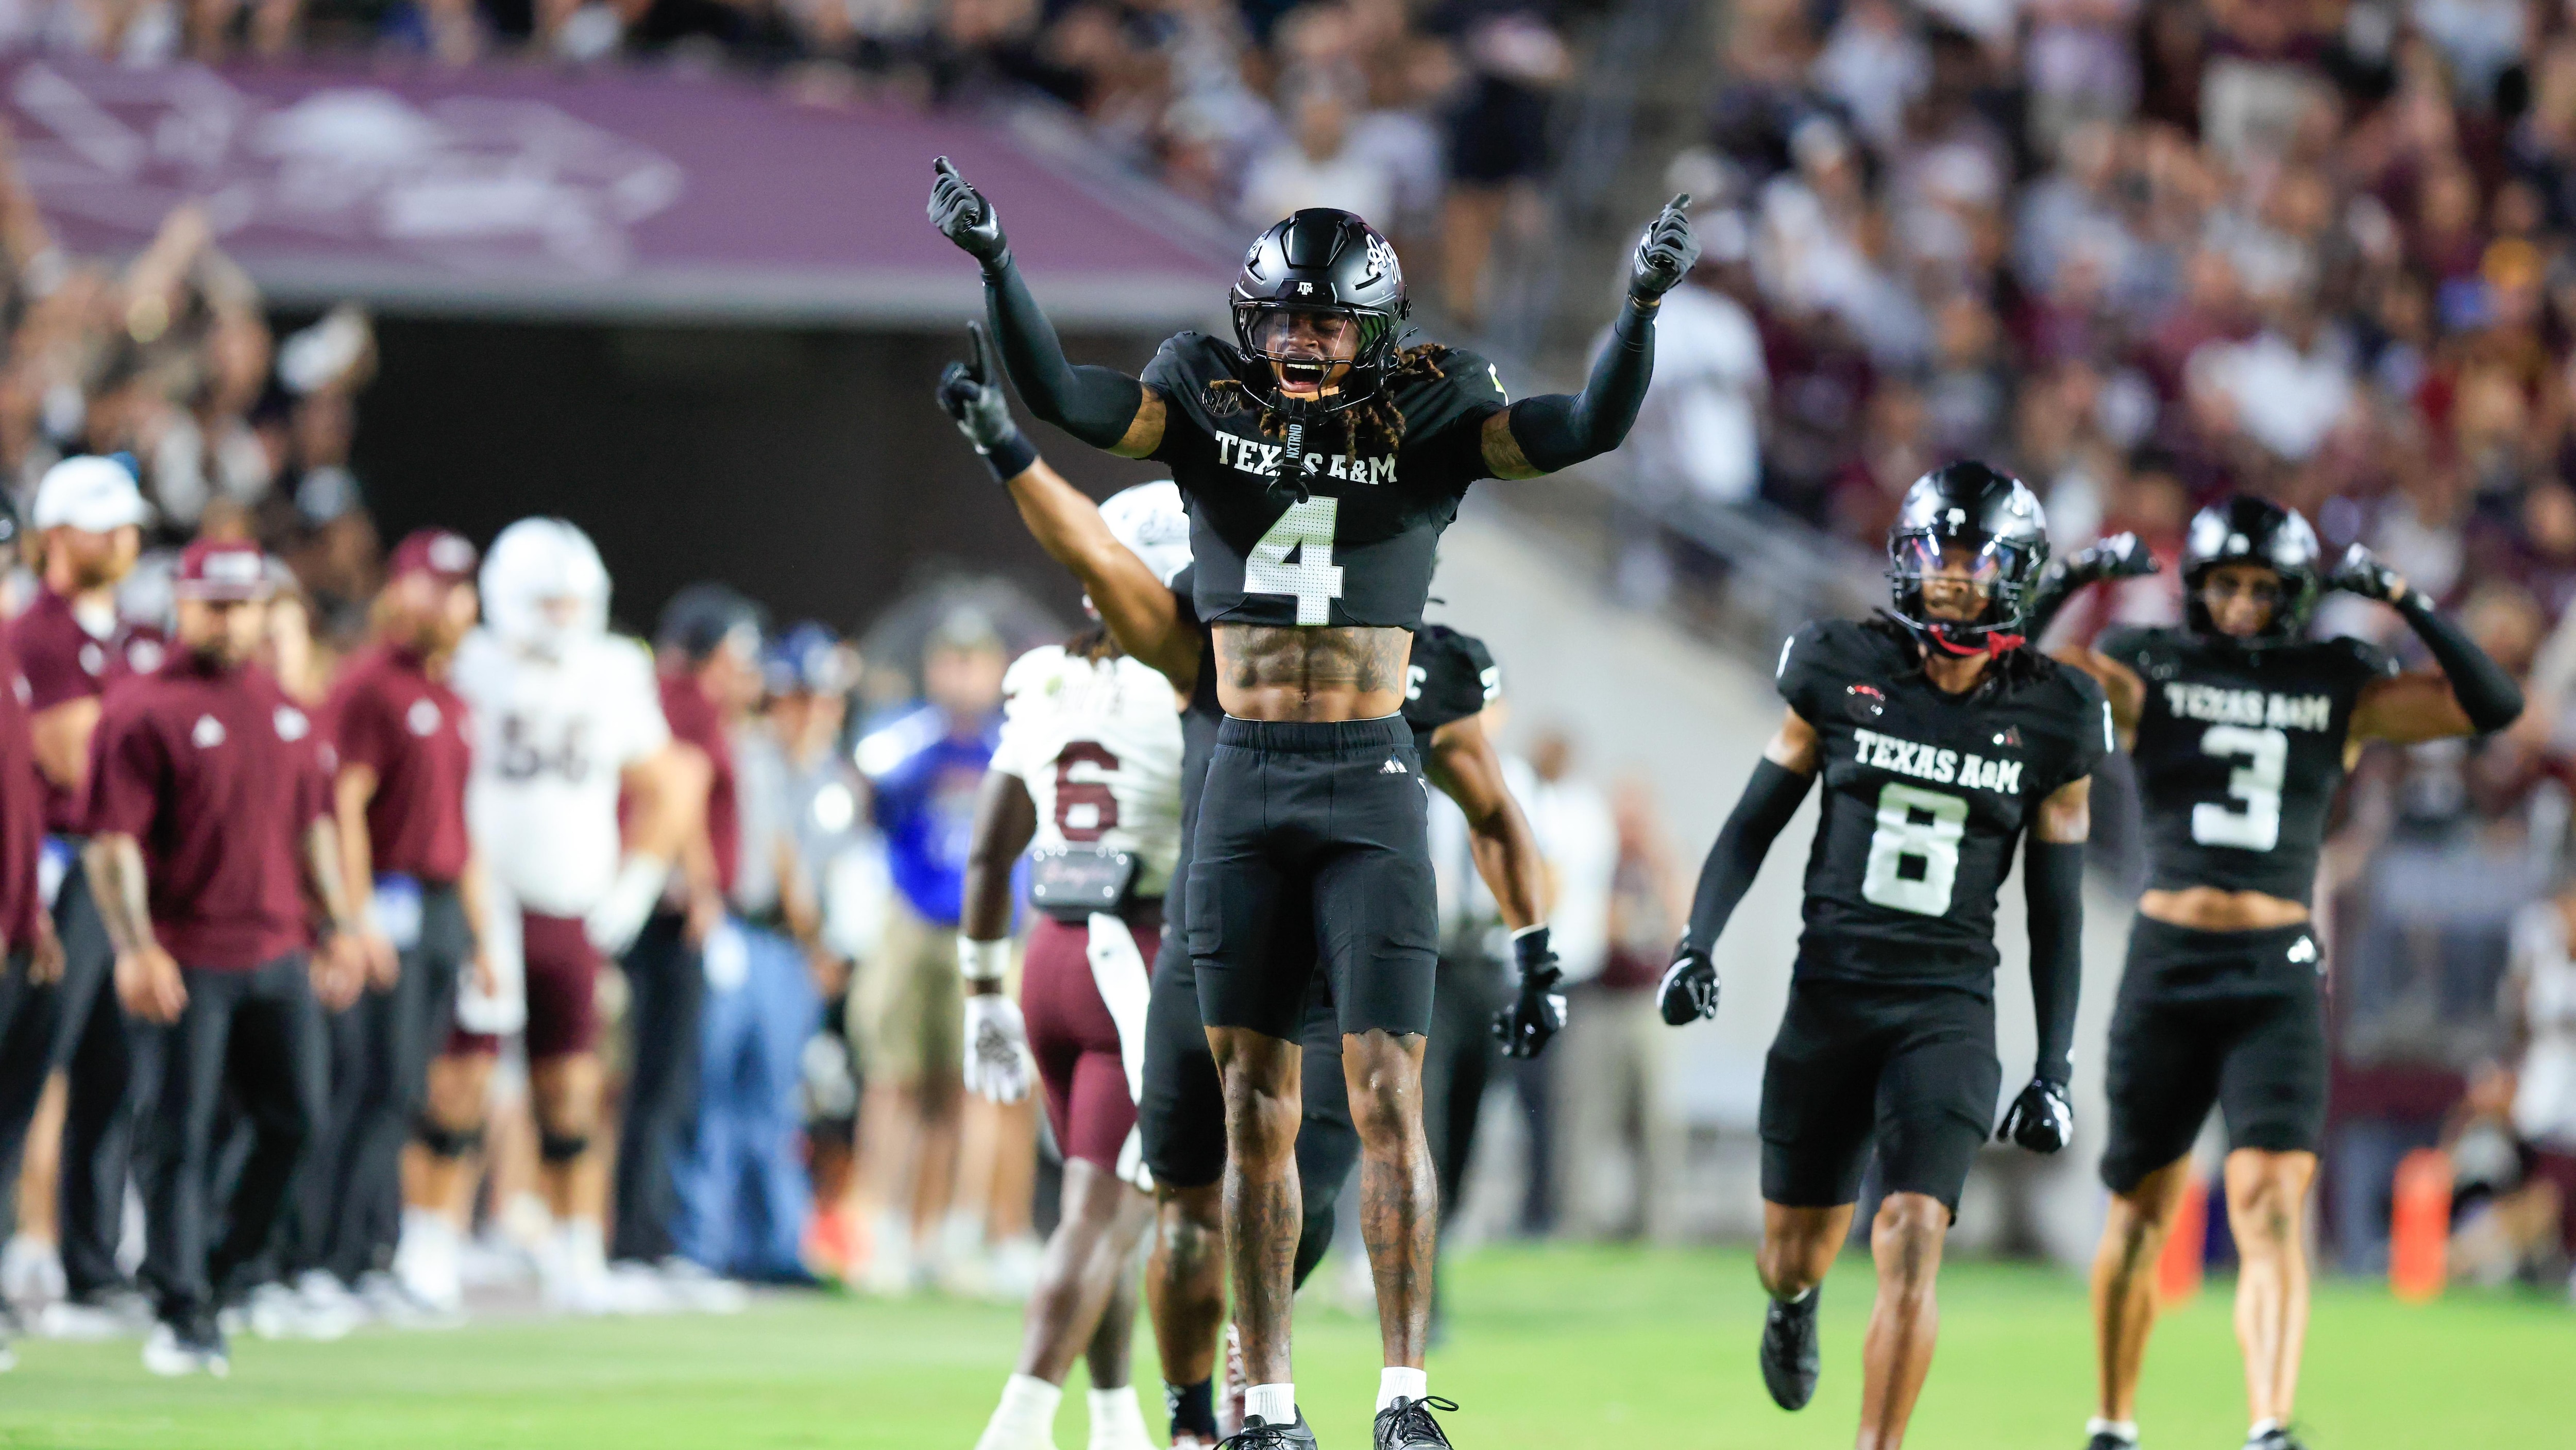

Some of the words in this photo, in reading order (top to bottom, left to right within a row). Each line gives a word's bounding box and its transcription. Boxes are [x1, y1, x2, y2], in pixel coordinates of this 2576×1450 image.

[1215, 430, 1323, 477] TEXS
[1327, 453, 1398, 485] A&M
[1285, 423, 1303, 459] NXTRND
[1242, 494, 1344, 626] 4
[1056, 740, 1119, 842] 6
[1853, 727, 1958, 784] TEXAS
[1957, 753, 2024, 795] A&M
[2192, 723, 2289, 852] 3
[1861, 781, 1970, 917] 8
